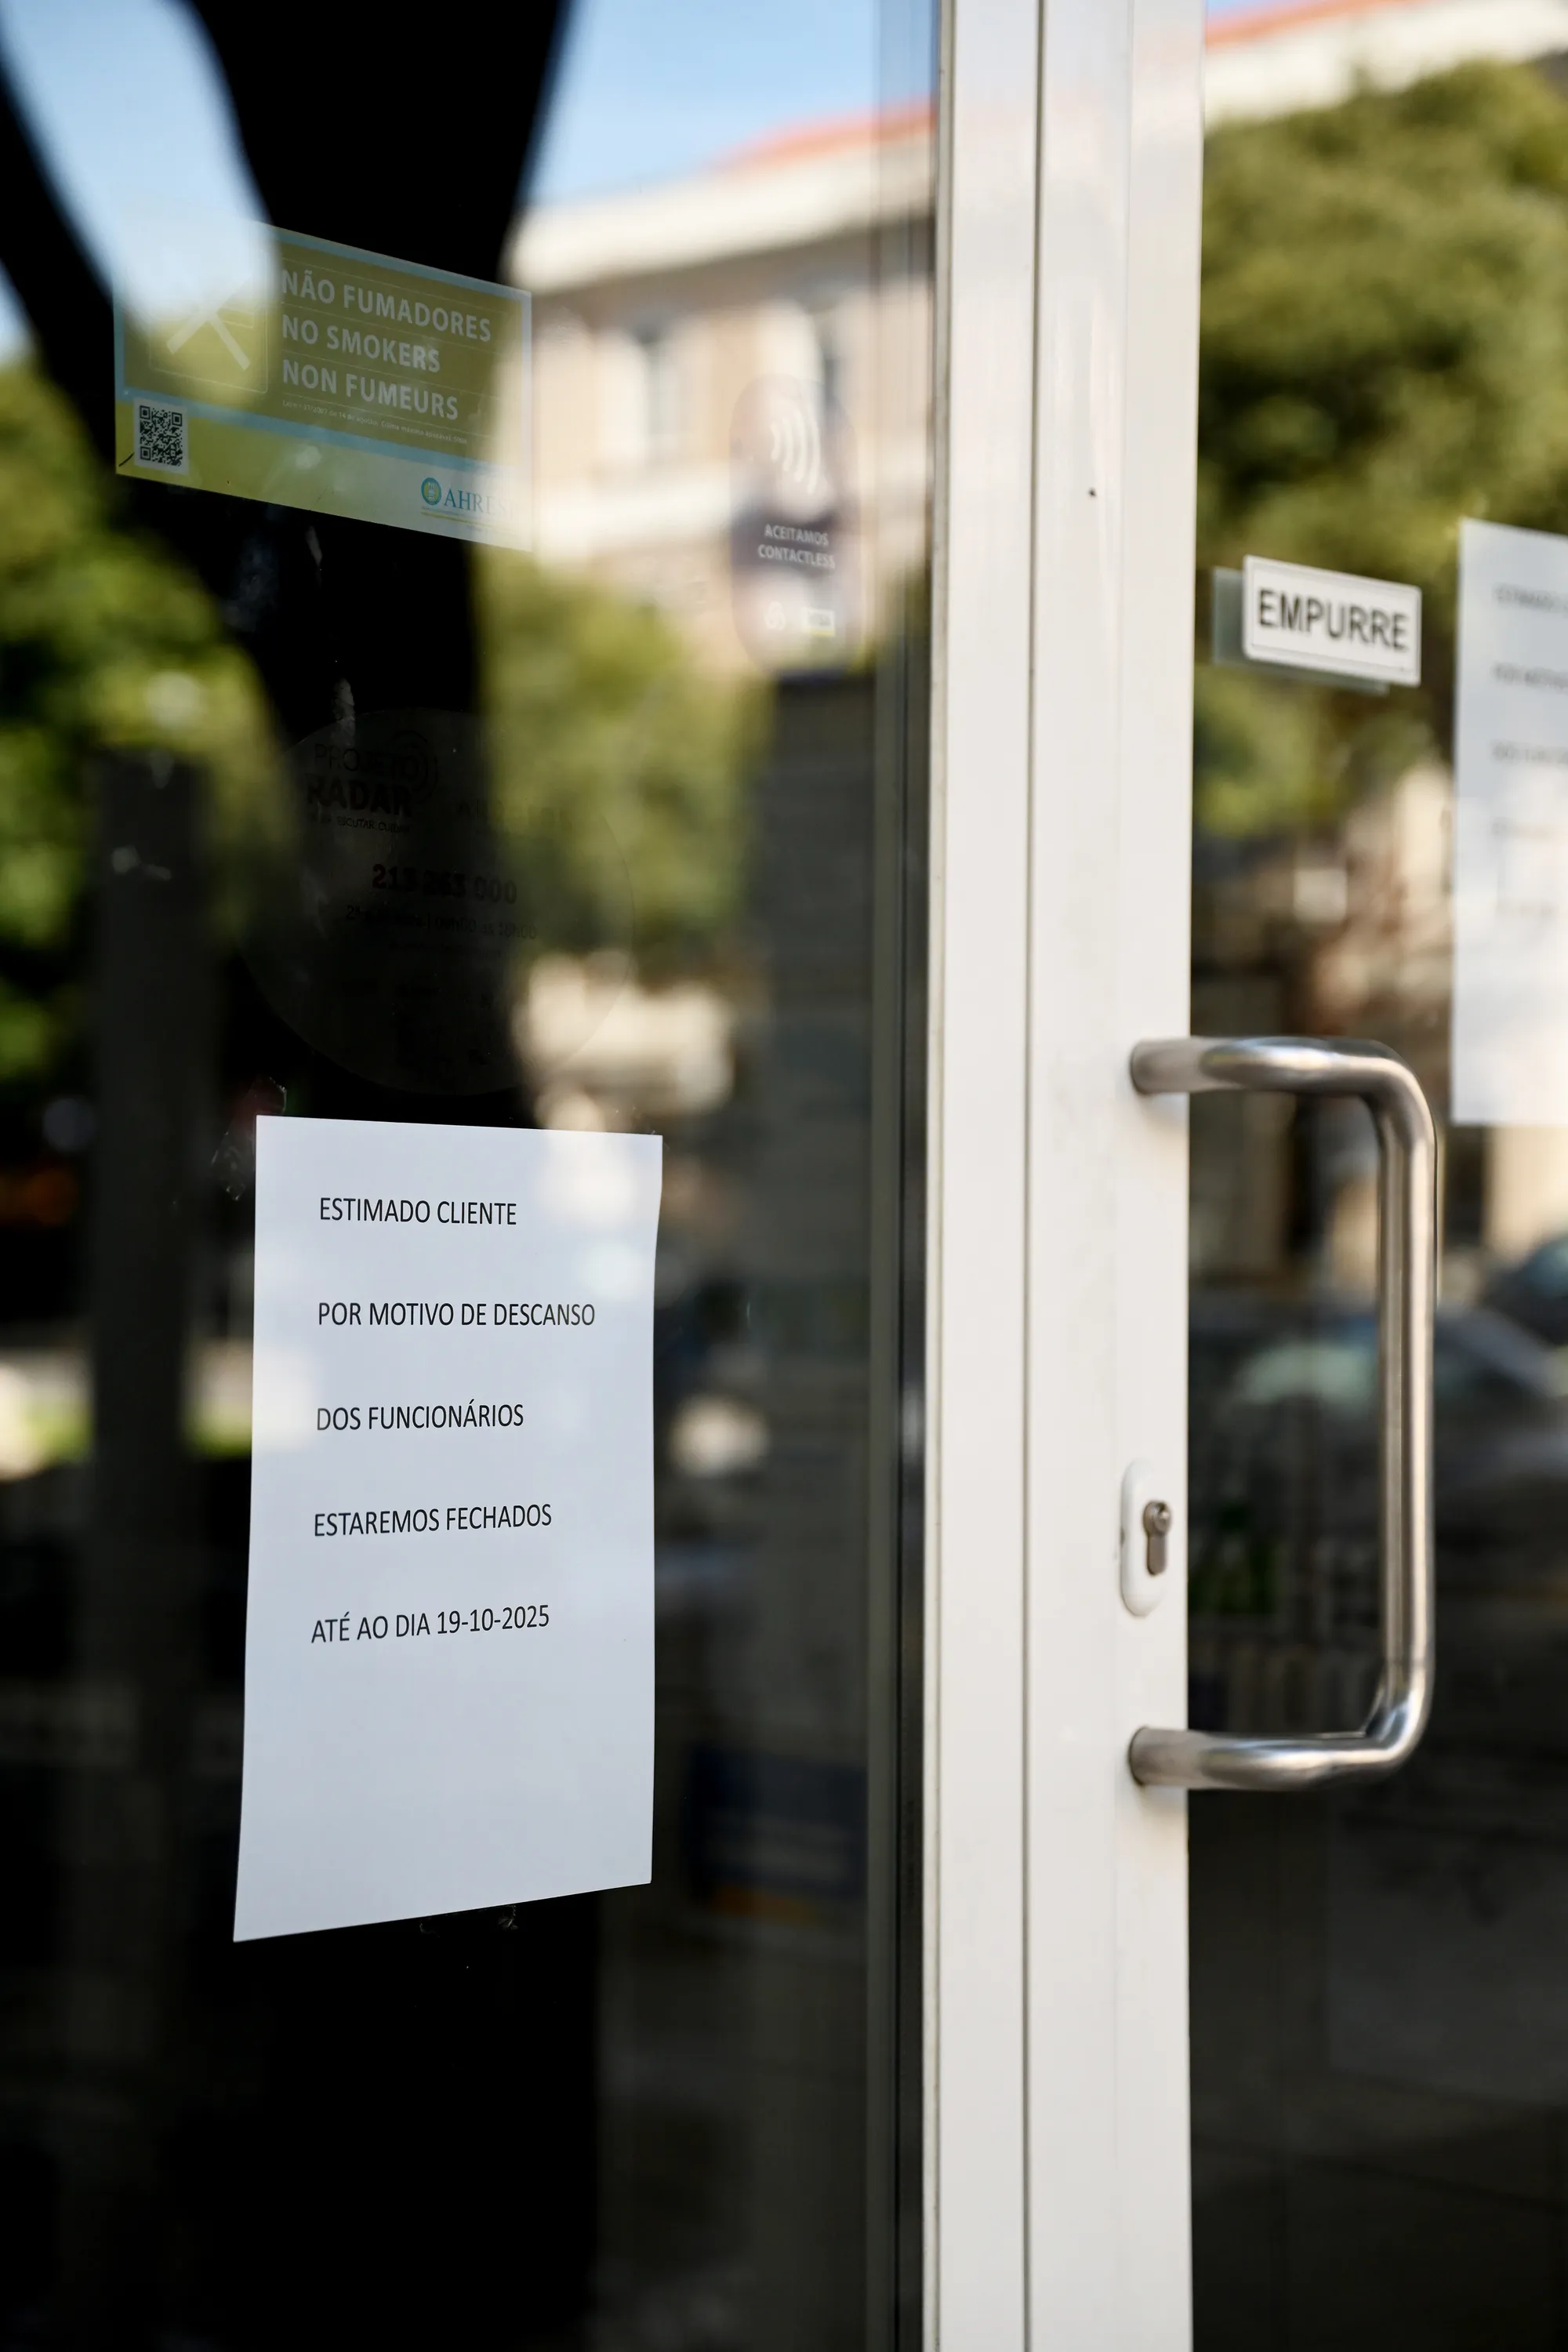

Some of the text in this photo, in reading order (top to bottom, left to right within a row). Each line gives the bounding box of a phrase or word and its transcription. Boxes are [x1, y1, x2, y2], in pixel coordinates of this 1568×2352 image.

[281, 269, 491, 342] NÃO FUMADORES
[282, 314, 440, 372] NO SMOKERS
[283, 359, 458, 420] NON FUMEURS
[765, 524, 829, 545] ACEITAMOS
[758, 544, 835, 568] CONTACTLESS
[1259, 590, 1410, 652] EMPURRE
[315, 742, 419, 779] PROJETO
[307, 772, 412, 818] RADAR
[474, 874, 518, 905] 000
[320, 1197, 517, 1225] ESTIMADO CLIENTE
[318, 1301, 595, 1327] POR MOTIVO DE DESCANSO
[317, 1398, 524, 1431] DOS FUNCIONÁRIOS
[314, 1503, 552, 1537] ESTAREMOS FECHADOS
[310, 1604, 550, 1644] ATÉ AO DIA 19-10-2025
